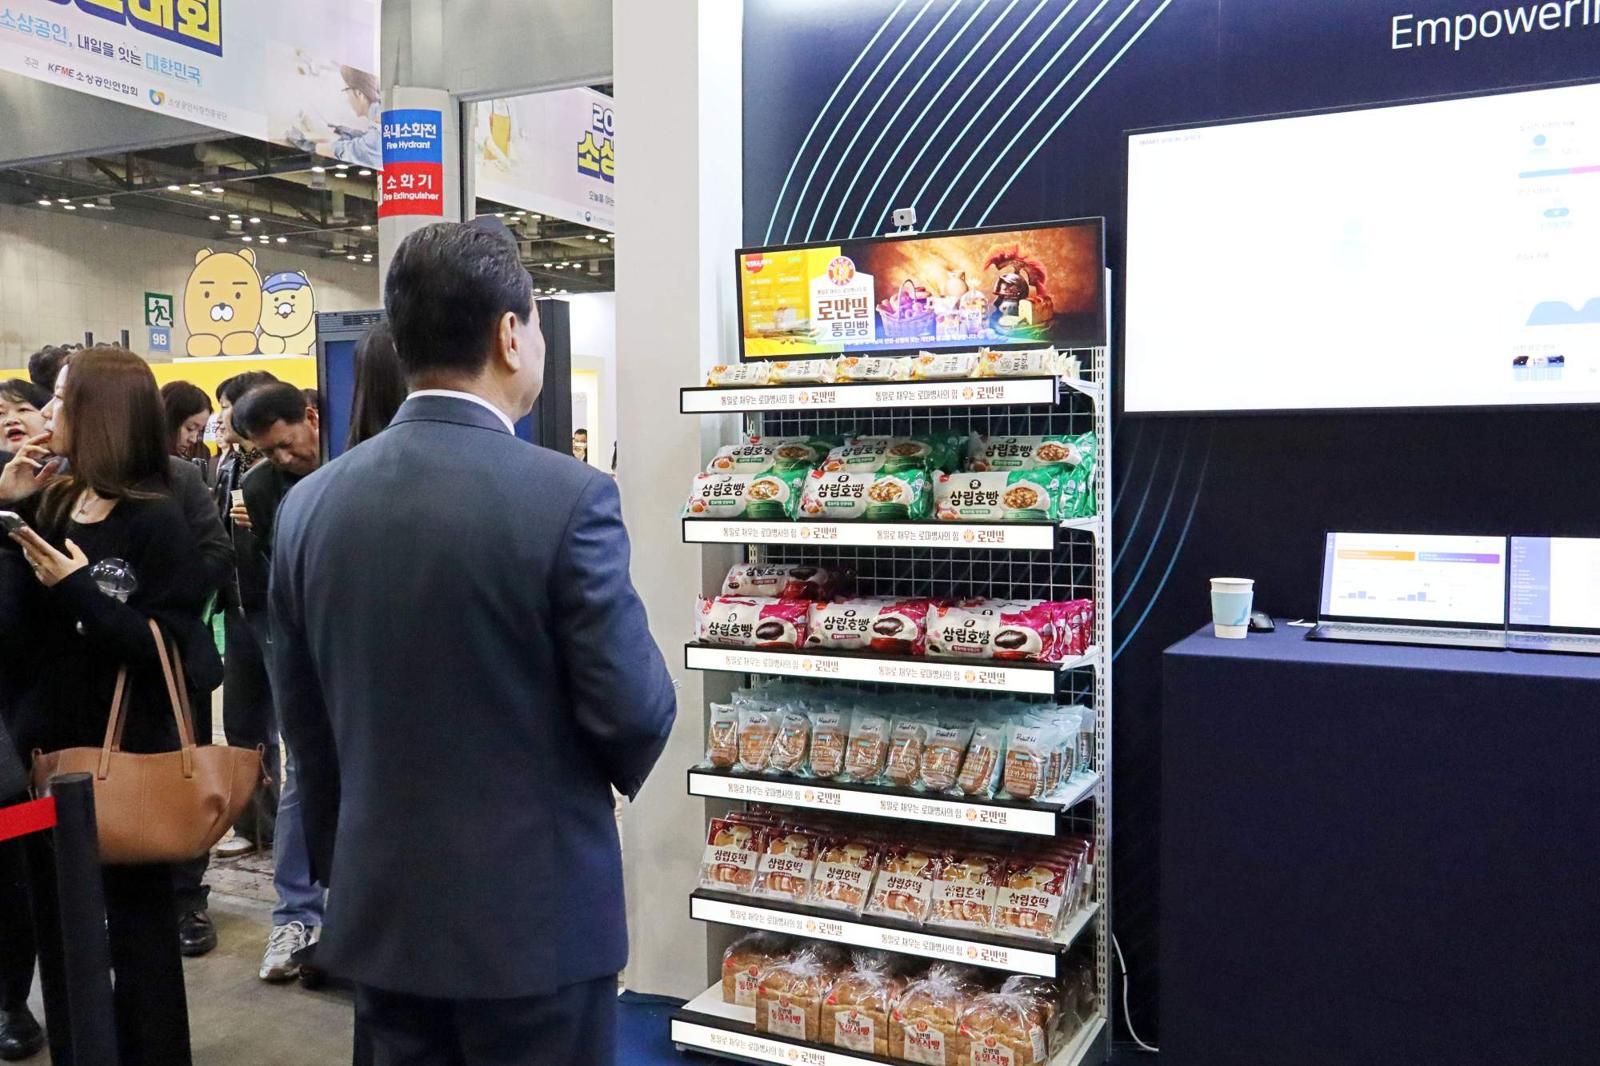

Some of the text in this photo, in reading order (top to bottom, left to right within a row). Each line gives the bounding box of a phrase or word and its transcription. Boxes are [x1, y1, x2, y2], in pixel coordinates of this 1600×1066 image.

[77, 34, 114, 58] 내일을
[118, 46, 142, 67] 잇는
[145, 52, 202, 84] 대한민국
[48, 62, 75, 78] KFME
[76, 72, 139, 97] 소상공인연합회
[383, 123, 437, 139] 옥내소화전
[386, 140, 431, 151] Fire Hydrant
[393, 192, 440, 201] Extinguisher
[816, 297, 869, 321] 로만밀
[831, 320, 869, 337] 통밀빵
[152, 333, 167, 345] 9B
[810, 391, 836, 403] 로만밀
[976, 386, 1004, 398] 로만밀
[985, 443, 1033, 458] 삼립호빵
[702, 483, 745, 497] 삼립호빵
[818, 484, 865, 498] 삼립호빵
[950, 490, 999, 506] 삼립호빵
[812, 526, 837, 539] 로만밀
[977, 529, 1004, 542] 로만밀
[708, 621, 753, 638] 삼립호빵
[823, 616, 871, 632] 삼립호빵
[942, 626, 991, 645] 삼립호빵
[815, 659, 838, 673] 로만밀
[978, 670, 1005, 684] 로만밀
[816, 790, 840, 805] 로만밀
[980, 809, 1006, 824] 로만밀
[714, 849, 748, 864] 삼립호떡
[767, 857, 804, 873] 삼립호떡
[887, 875, 923, 893] 삼립호떡
[1009, 891, 1050, 909] 삼립호떡
[818, 921, 842, 936] 로만밀
[980, 947, 1008, 964] 로만밀
[800, 1049, 824, 1066] 로만밀
